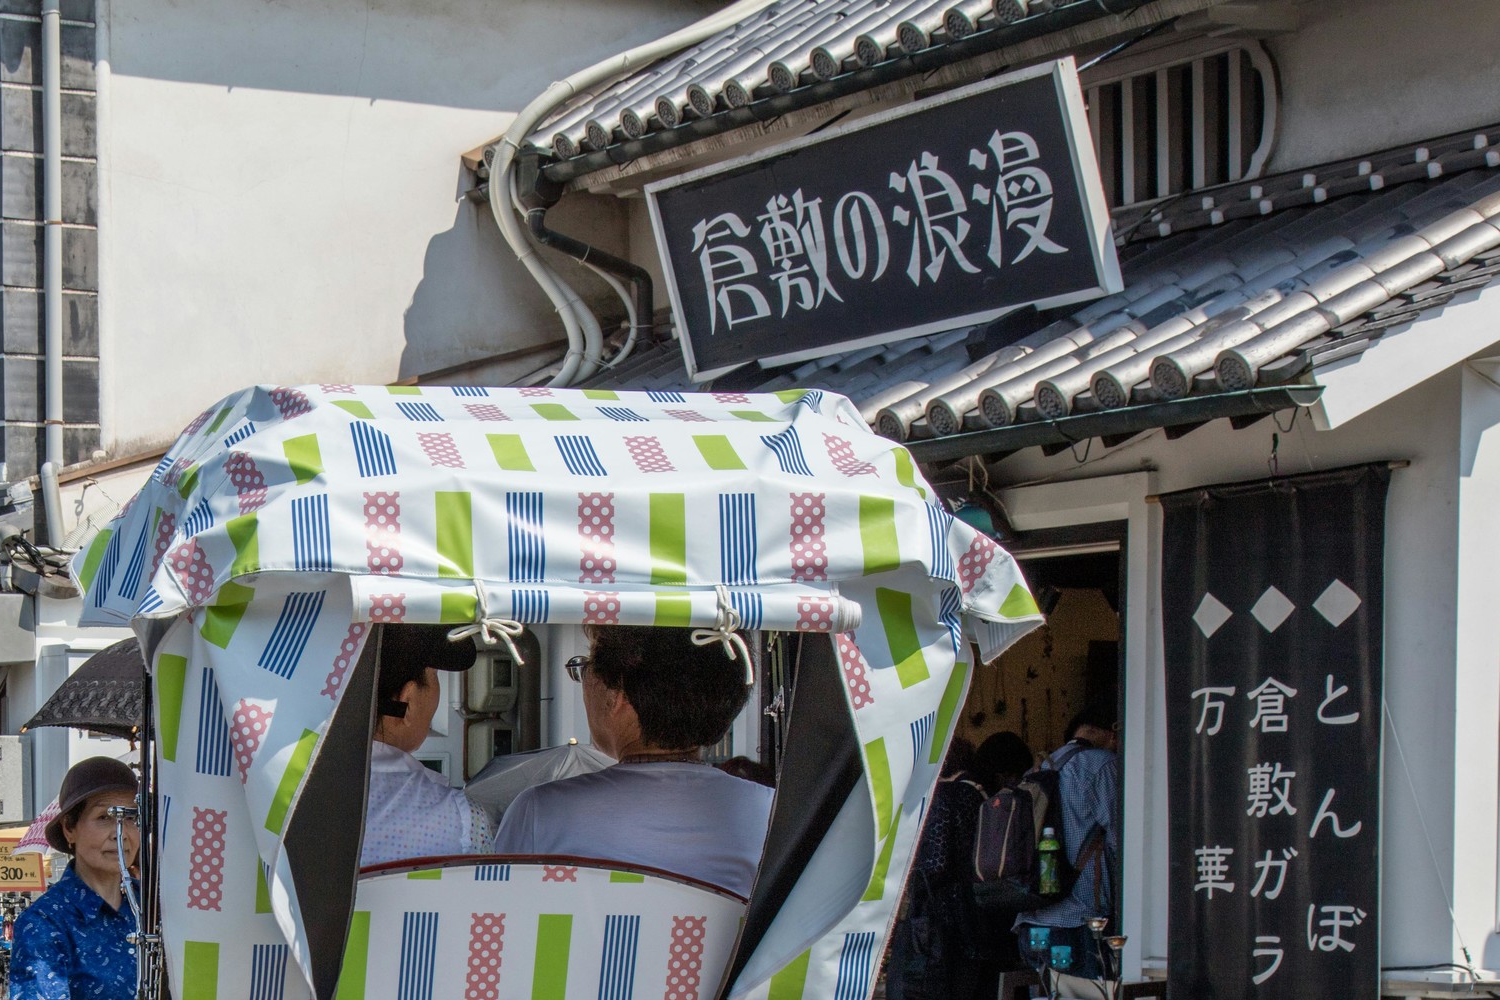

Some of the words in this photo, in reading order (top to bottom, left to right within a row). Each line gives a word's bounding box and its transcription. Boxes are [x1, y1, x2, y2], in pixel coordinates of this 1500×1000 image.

[691, 128, 1070, 336] 倉敷の浪漫
